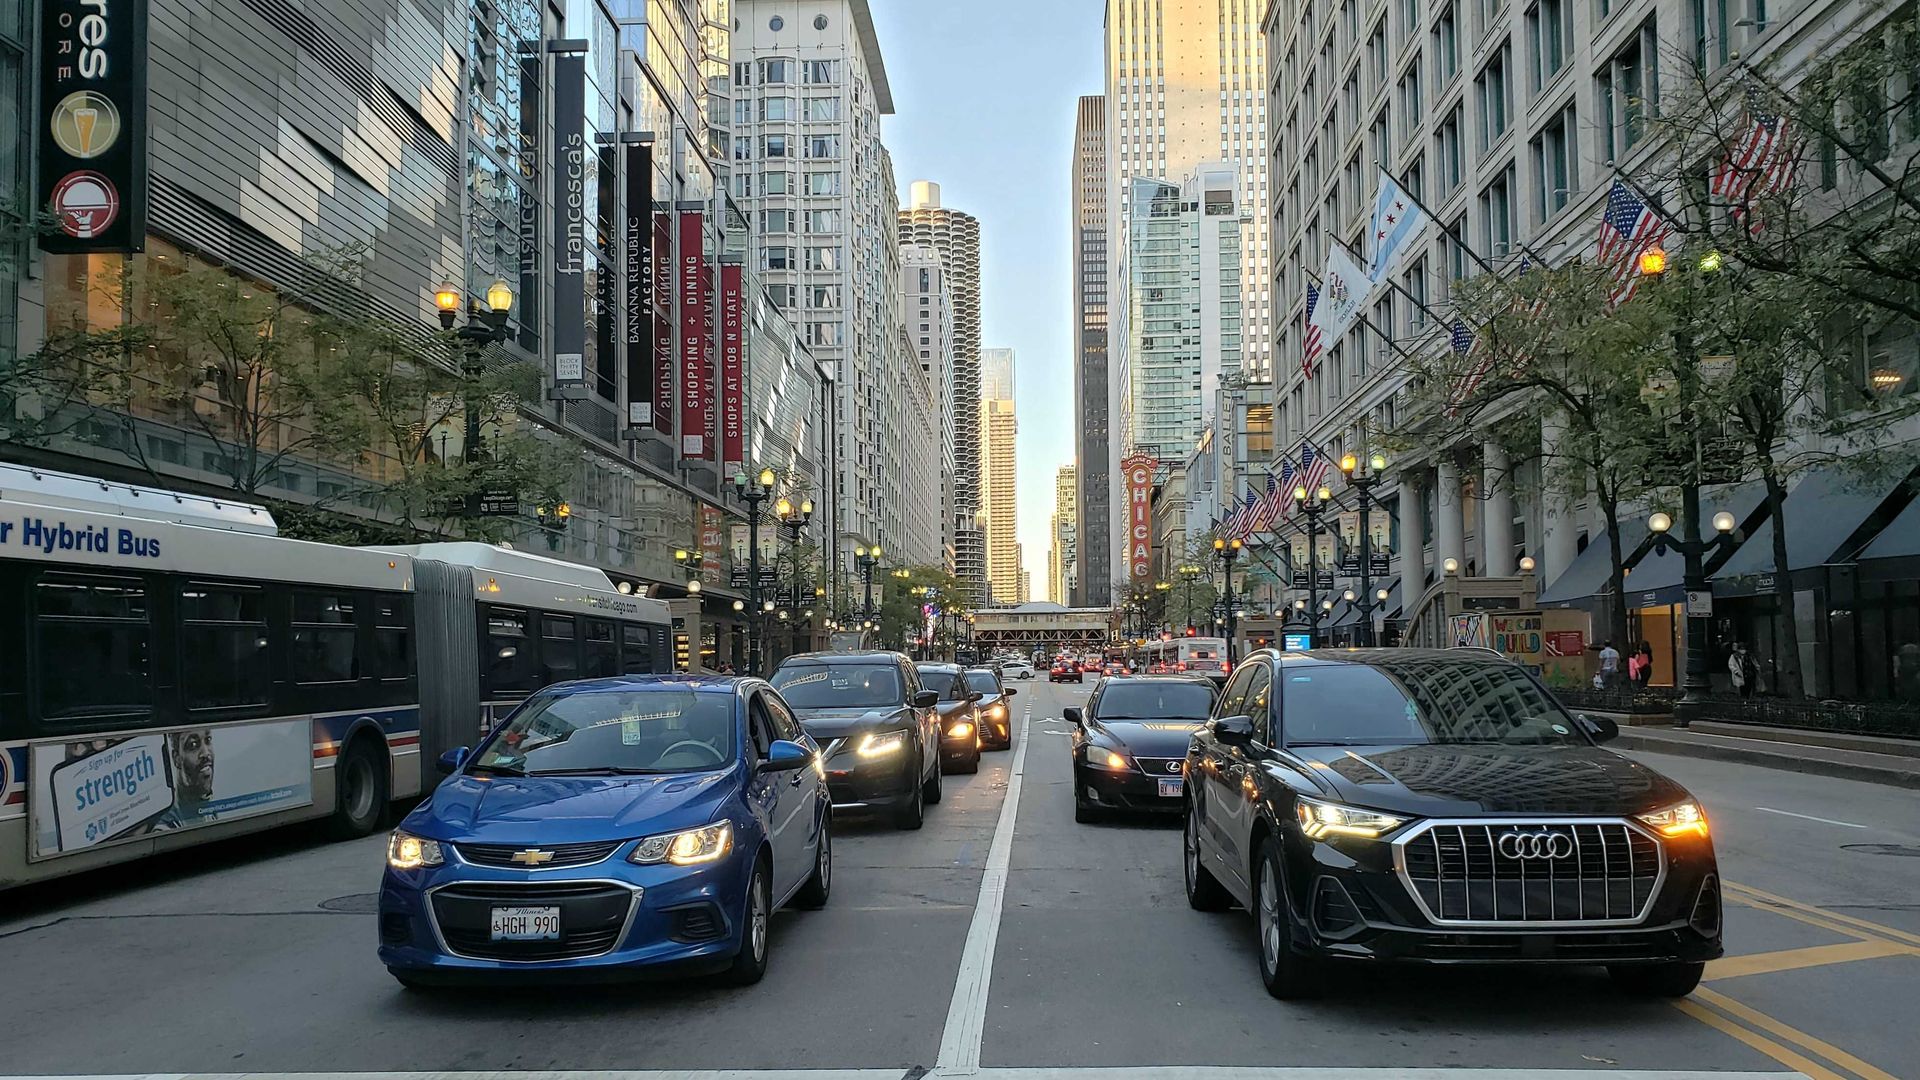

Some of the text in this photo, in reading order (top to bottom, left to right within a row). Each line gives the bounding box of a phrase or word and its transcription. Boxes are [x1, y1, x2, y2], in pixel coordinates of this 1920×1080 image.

[556, 132, 582, 276] francesca's
[628, 216, 640, 344] BANANA REPUBLIC
[643, 246, 652, 314] FACTORY
[686, 256, 698, 305] DINING
[687, 337, 699, 409] SHOPPING
[727, 290, 738, 438] SHOPS AT 108 N STATE
[1223, 391, 1232, 456] BALLET
[23, 517, 109, 553] Hybrid
[118, 529, 160, 557] Bus
[1132, 468, 1149, 578] CHICAG
[1495, 618, 1541, 632] WE CAN
[1496, 633, 1540, 653] BUILD
[75, 750, 155, 811] strength
[88, 749, 123, 770] Sign up for
[502, 916, 559, 934] HGH 990
